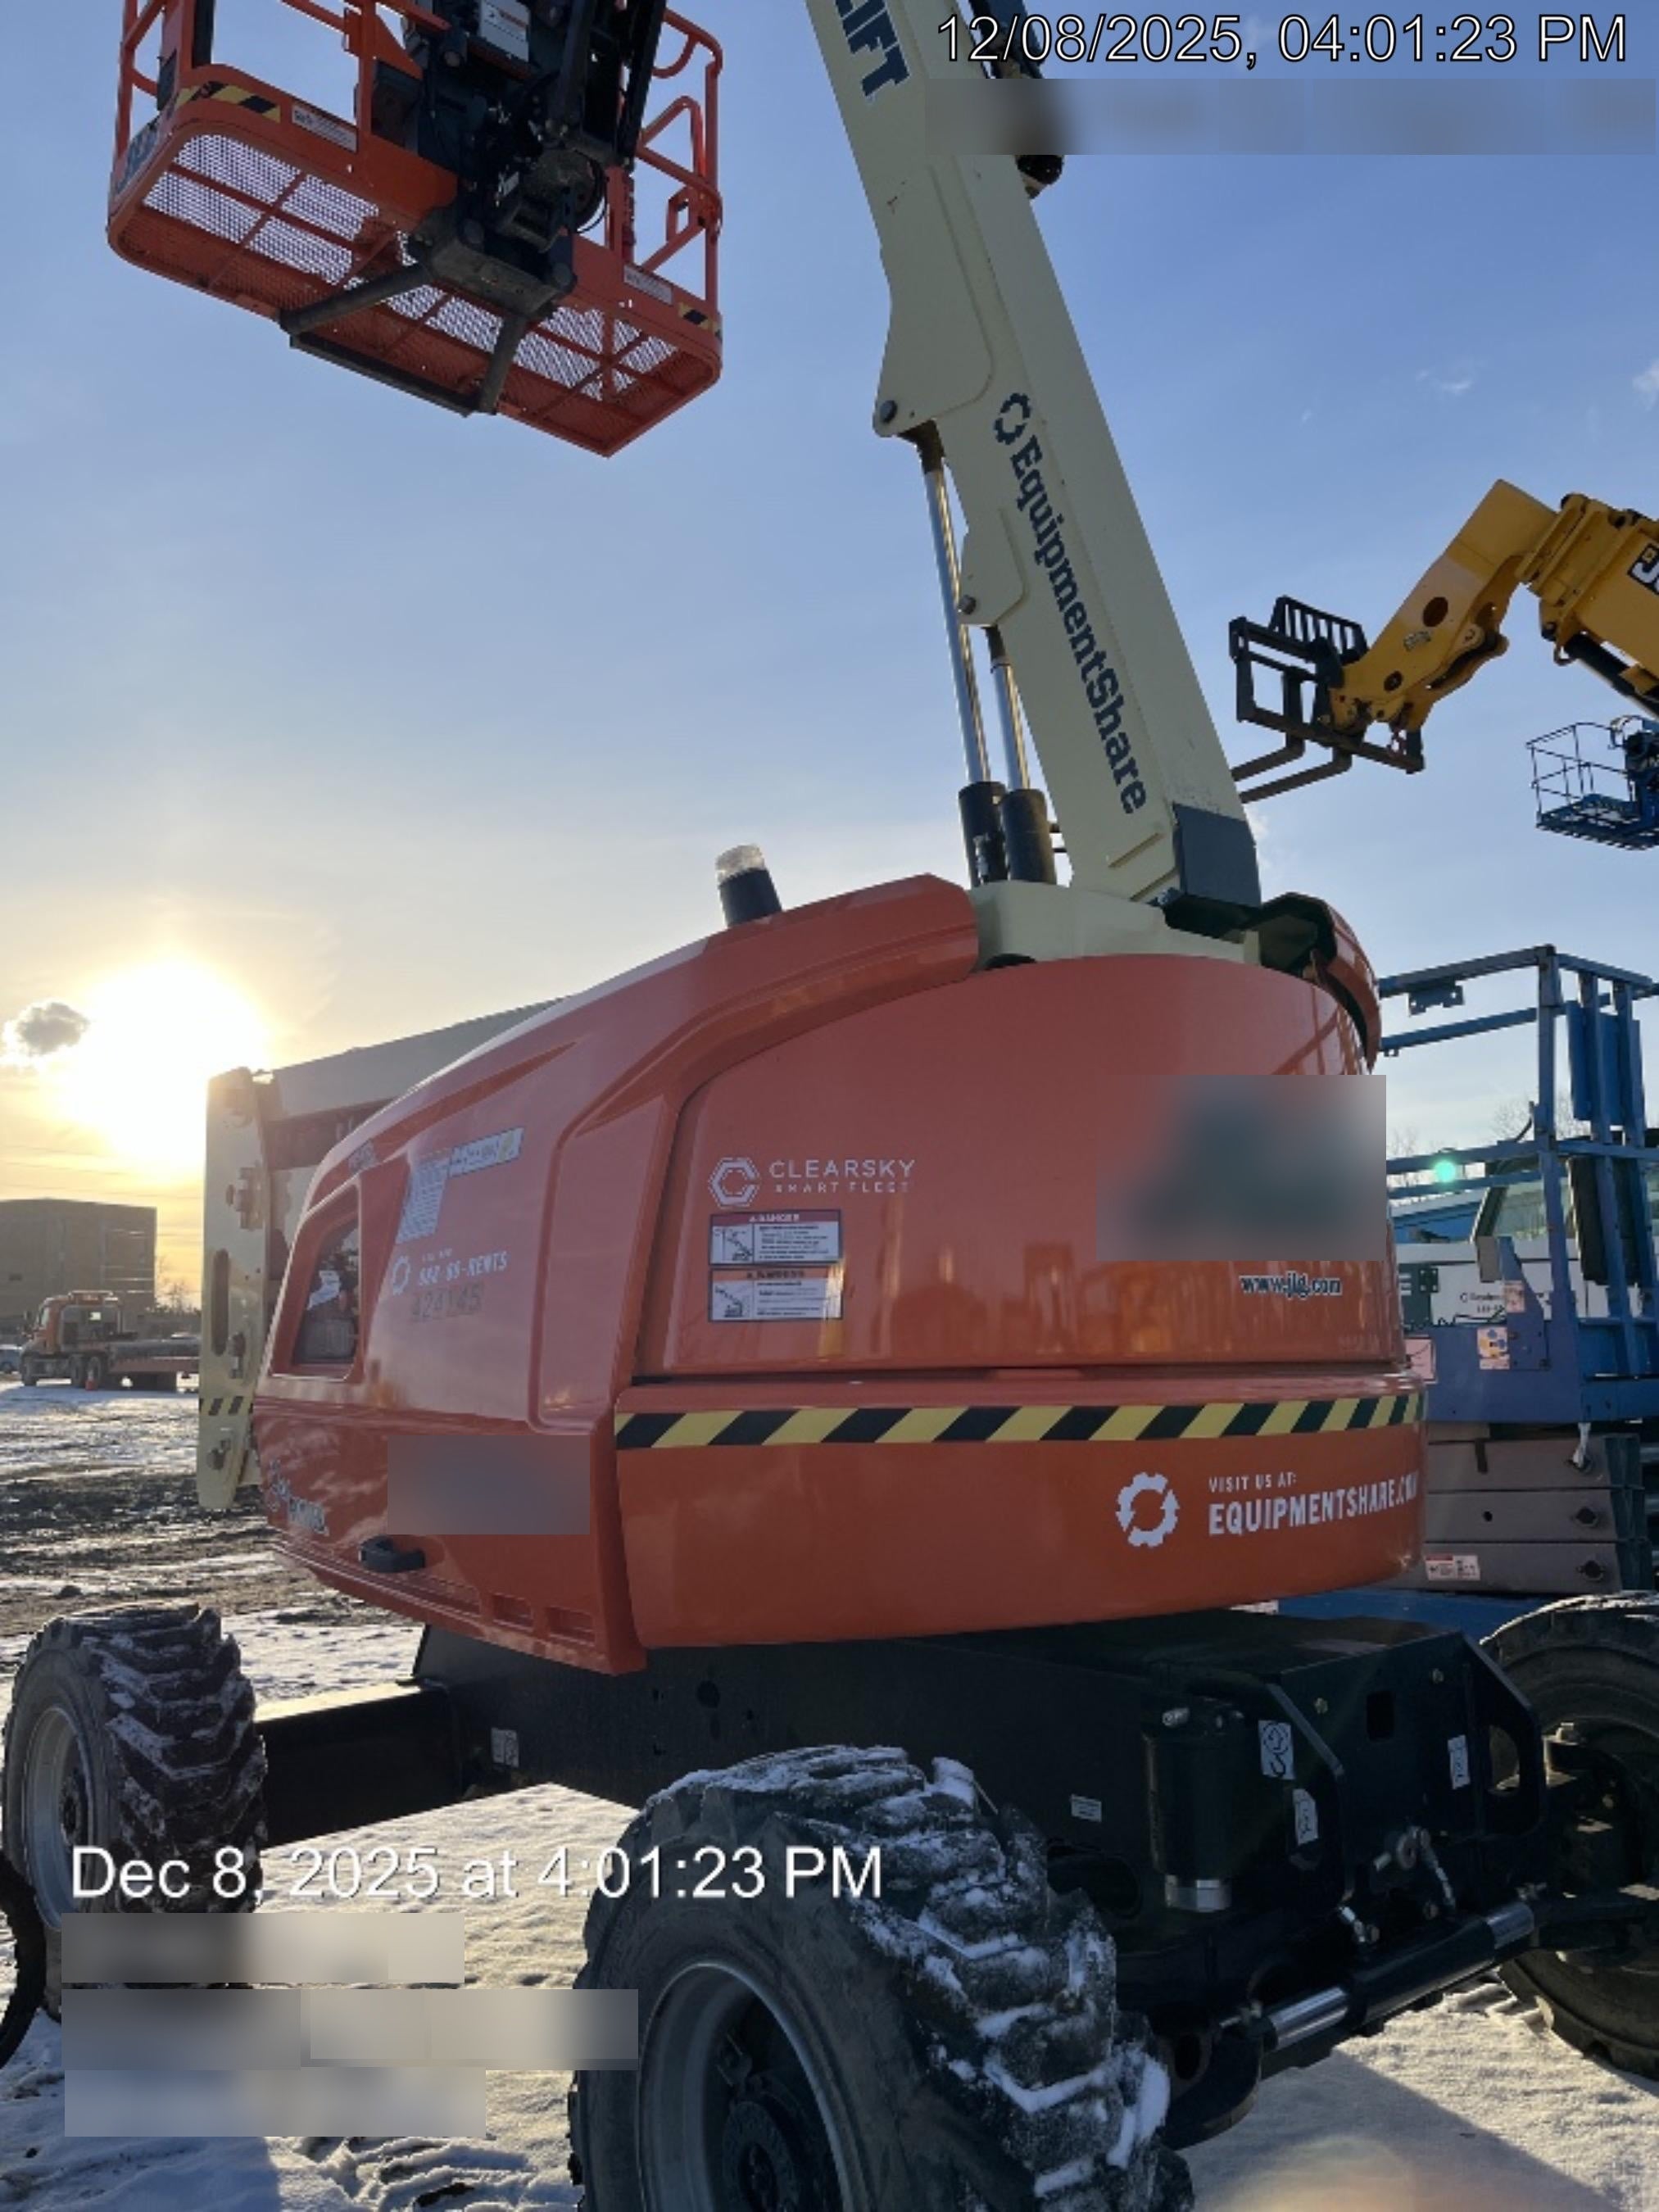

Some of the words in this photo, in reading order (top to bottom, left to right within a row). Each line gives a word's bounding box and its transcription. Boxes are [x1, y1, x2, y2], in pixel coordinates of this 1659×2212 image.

[1009, 434, 1147, 814] EquipmentShare
[768, 1158, 916, 1178] CLEARSKY
[775, 1181, 841, 1194] SMART
[849, 1181, 910, 1194] FLEET
[1240, 1271, 1344, 1299] www.jlg.com
[1208, 1475, 1249, 1493] VISIT
[1255, 1475, 1272, 1489] US
[1277, 1472, 1298, 1487] AT:
